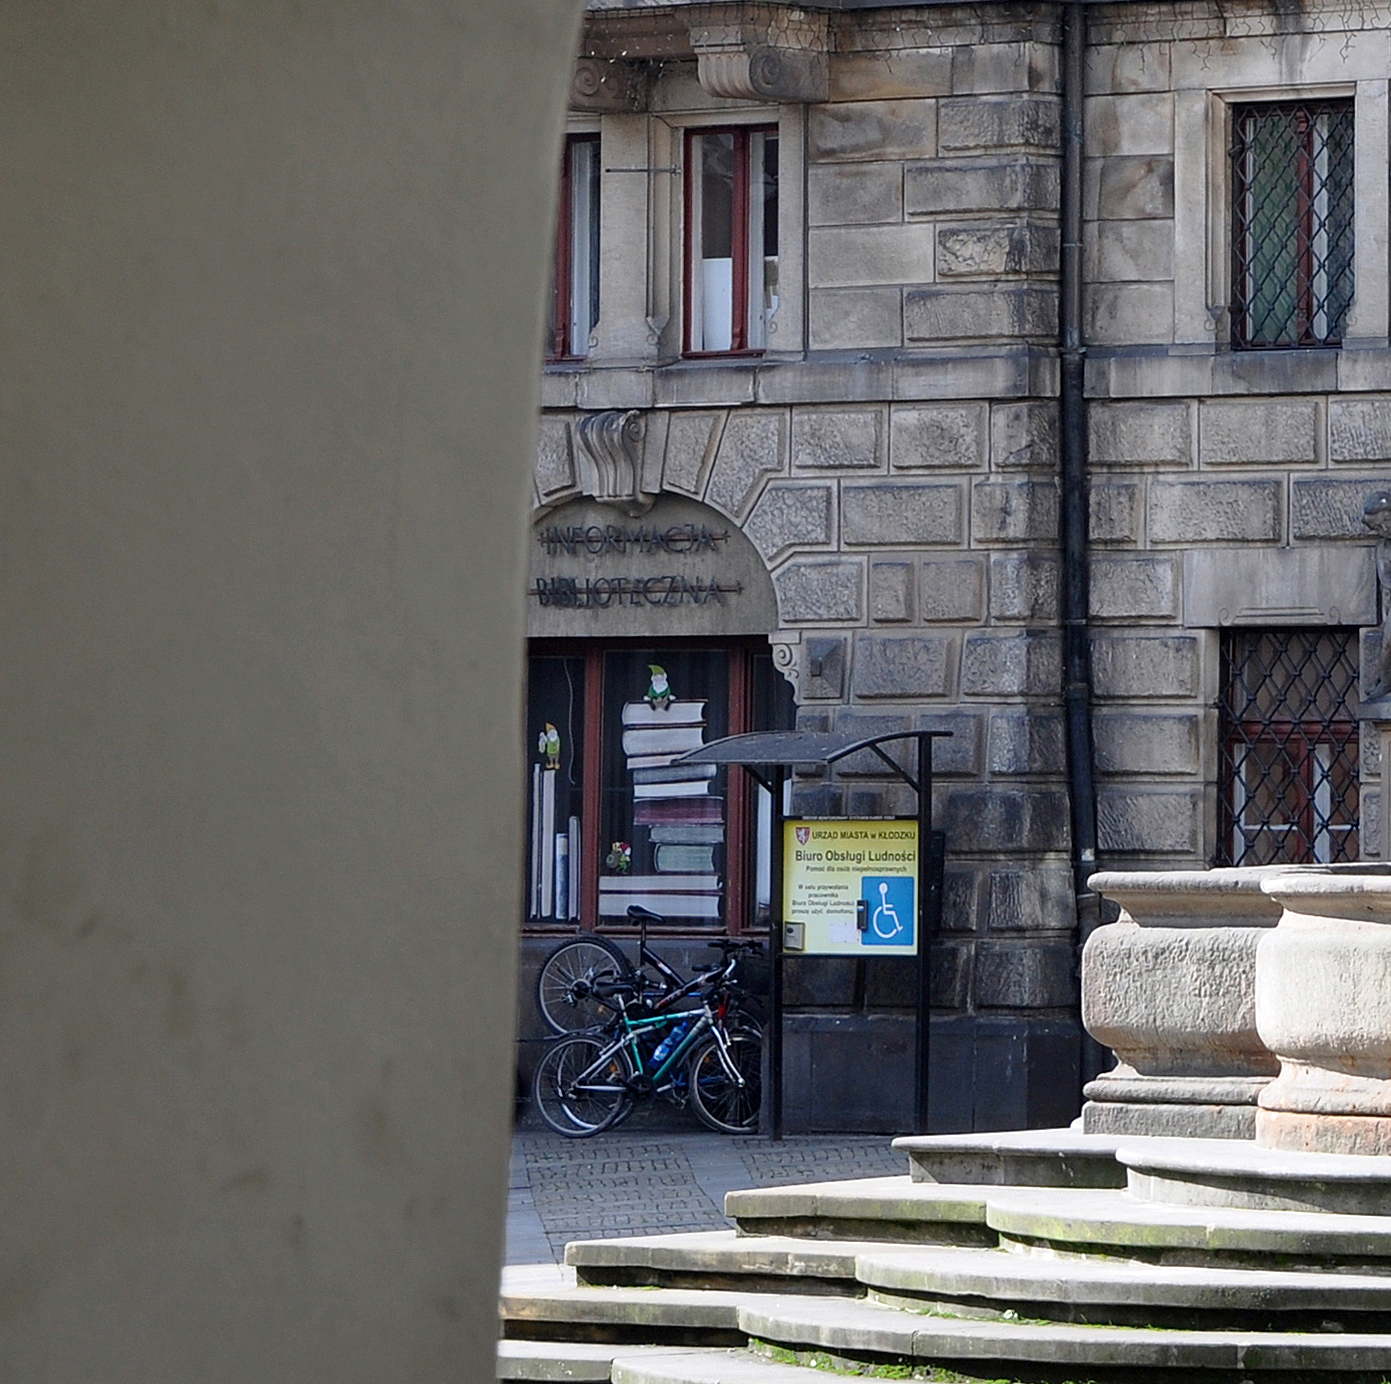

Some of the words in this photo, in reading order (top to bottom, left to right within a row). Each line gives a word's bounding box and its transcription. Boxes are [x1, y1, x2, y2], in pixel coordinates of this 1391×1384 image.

[546, 524, 717, 555] INFORMACJA
[536, 575, 723, 607] BIBLIOTECZNA
[812, 831, 838, 841] URZĄD
[840, 831, 869, 839] MIASTA
[878, 831, 915, 839] KŁODZKU
[795, 850, 823, 861] Biuro
[825, 850, 866, 864] Obsługi
[868, 850, 916, 861] Ludności
